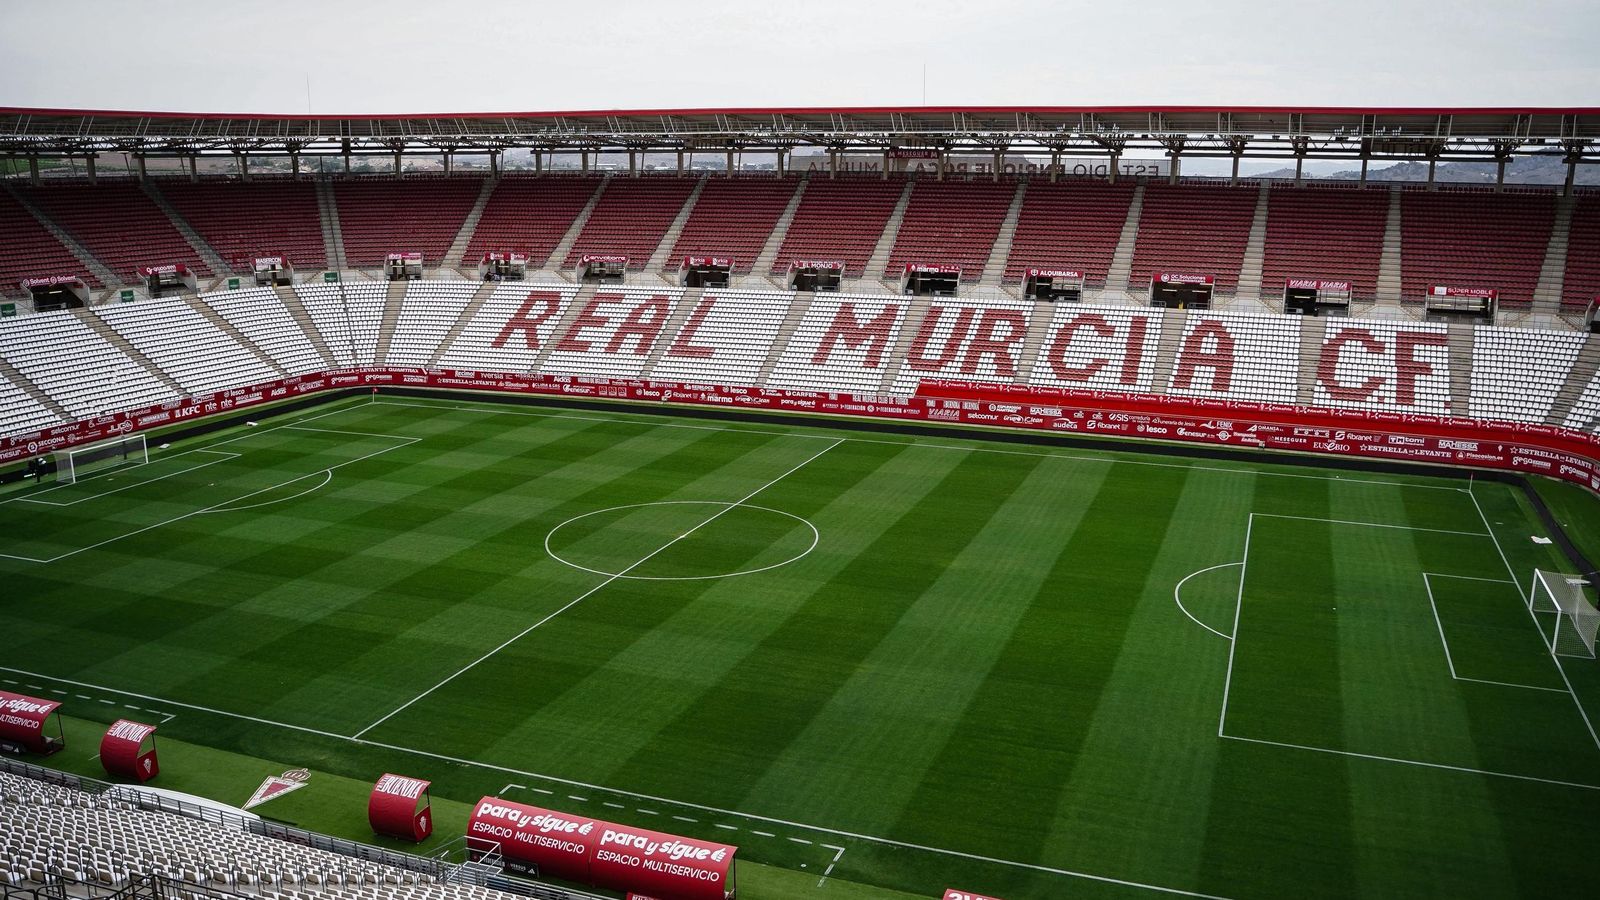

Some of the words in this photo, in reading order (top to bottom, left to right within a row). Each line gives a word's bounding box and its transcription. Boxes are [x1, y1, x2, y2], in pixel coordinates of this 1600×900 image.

[490, 290, 717, 358] REAL
[813, 302, 1235, 391] MURCIA
[1315, 327, 1449, 405] CF
[230, 389, 245, 397] lesco
[182, 405, 200, 416] KFC
[928, 408, 960, 416] VIARIA
[1116, 414, 1128, 422] SIS
[1097, 422, 1120, 430] fibranet
[1146, 425, 1167, 433] lesco
[38, 436, 65, 446] SECCIONA
[1347, 433, 1372, 441] fibranet
[1368, 445, 1408, 454] ESTRELLA
[1415, 449, 1451, 457] LEVANTE
[1518, 448, 1559, 459] ESTRELLA
[1565, 456, 1592, 469] LEVANTE
[477, 802, 522, 822] para
[517, 815, 532, 827] y
[473, 821, 512, 838] ESPACIO
[514, 831, 585, 854] MULTISERVICIO
[600, 830, 649, 849] para
[644, 842, 659, 855] y
[596, 850, 640, 866] ESPACIO
[643, 859, 720, 882] MULTISERVICIO
